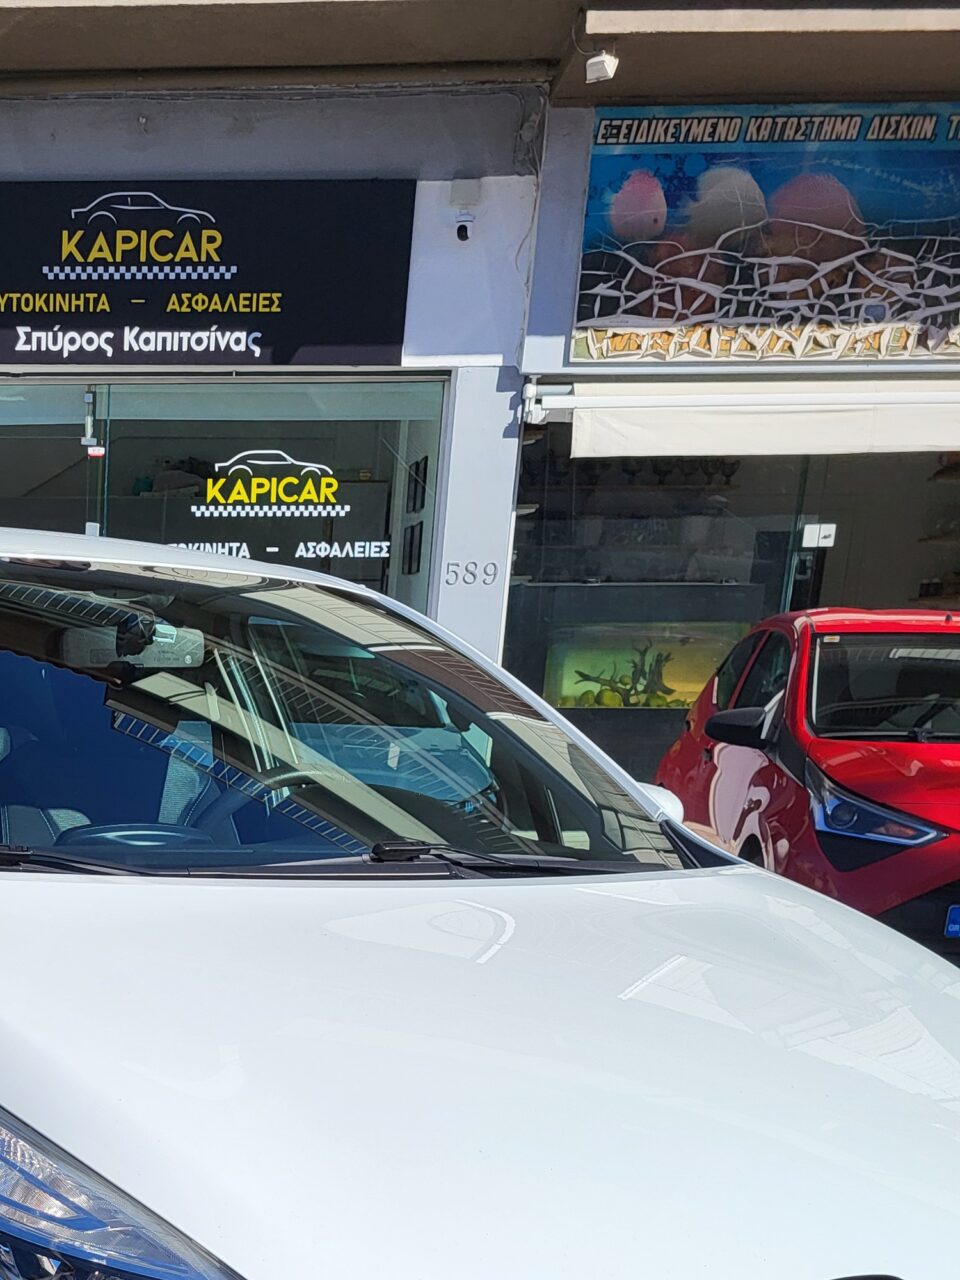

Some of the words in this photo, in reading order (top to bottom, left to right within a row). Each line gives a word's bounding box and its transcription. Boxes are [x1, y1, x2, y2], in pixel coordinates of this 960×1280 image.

[744, 115, 862, 143] ΚΑΤΑΣΤΗΜΑ
[61, 229, 224, 262] KAPICAR
[166, 293, 282, 312] ΑΣΦΑΛΕΙΕΣ
[14, 325, 115, 358] Σπύρος
[123, 325, 263, 358] Καπιτσίνας
[206, 476, 339, 503] KAPICAR
[295, 541, 390, 558] ΑΣΦΑΛΕΙΕΣ
[445, 561, 497, 586] 589
